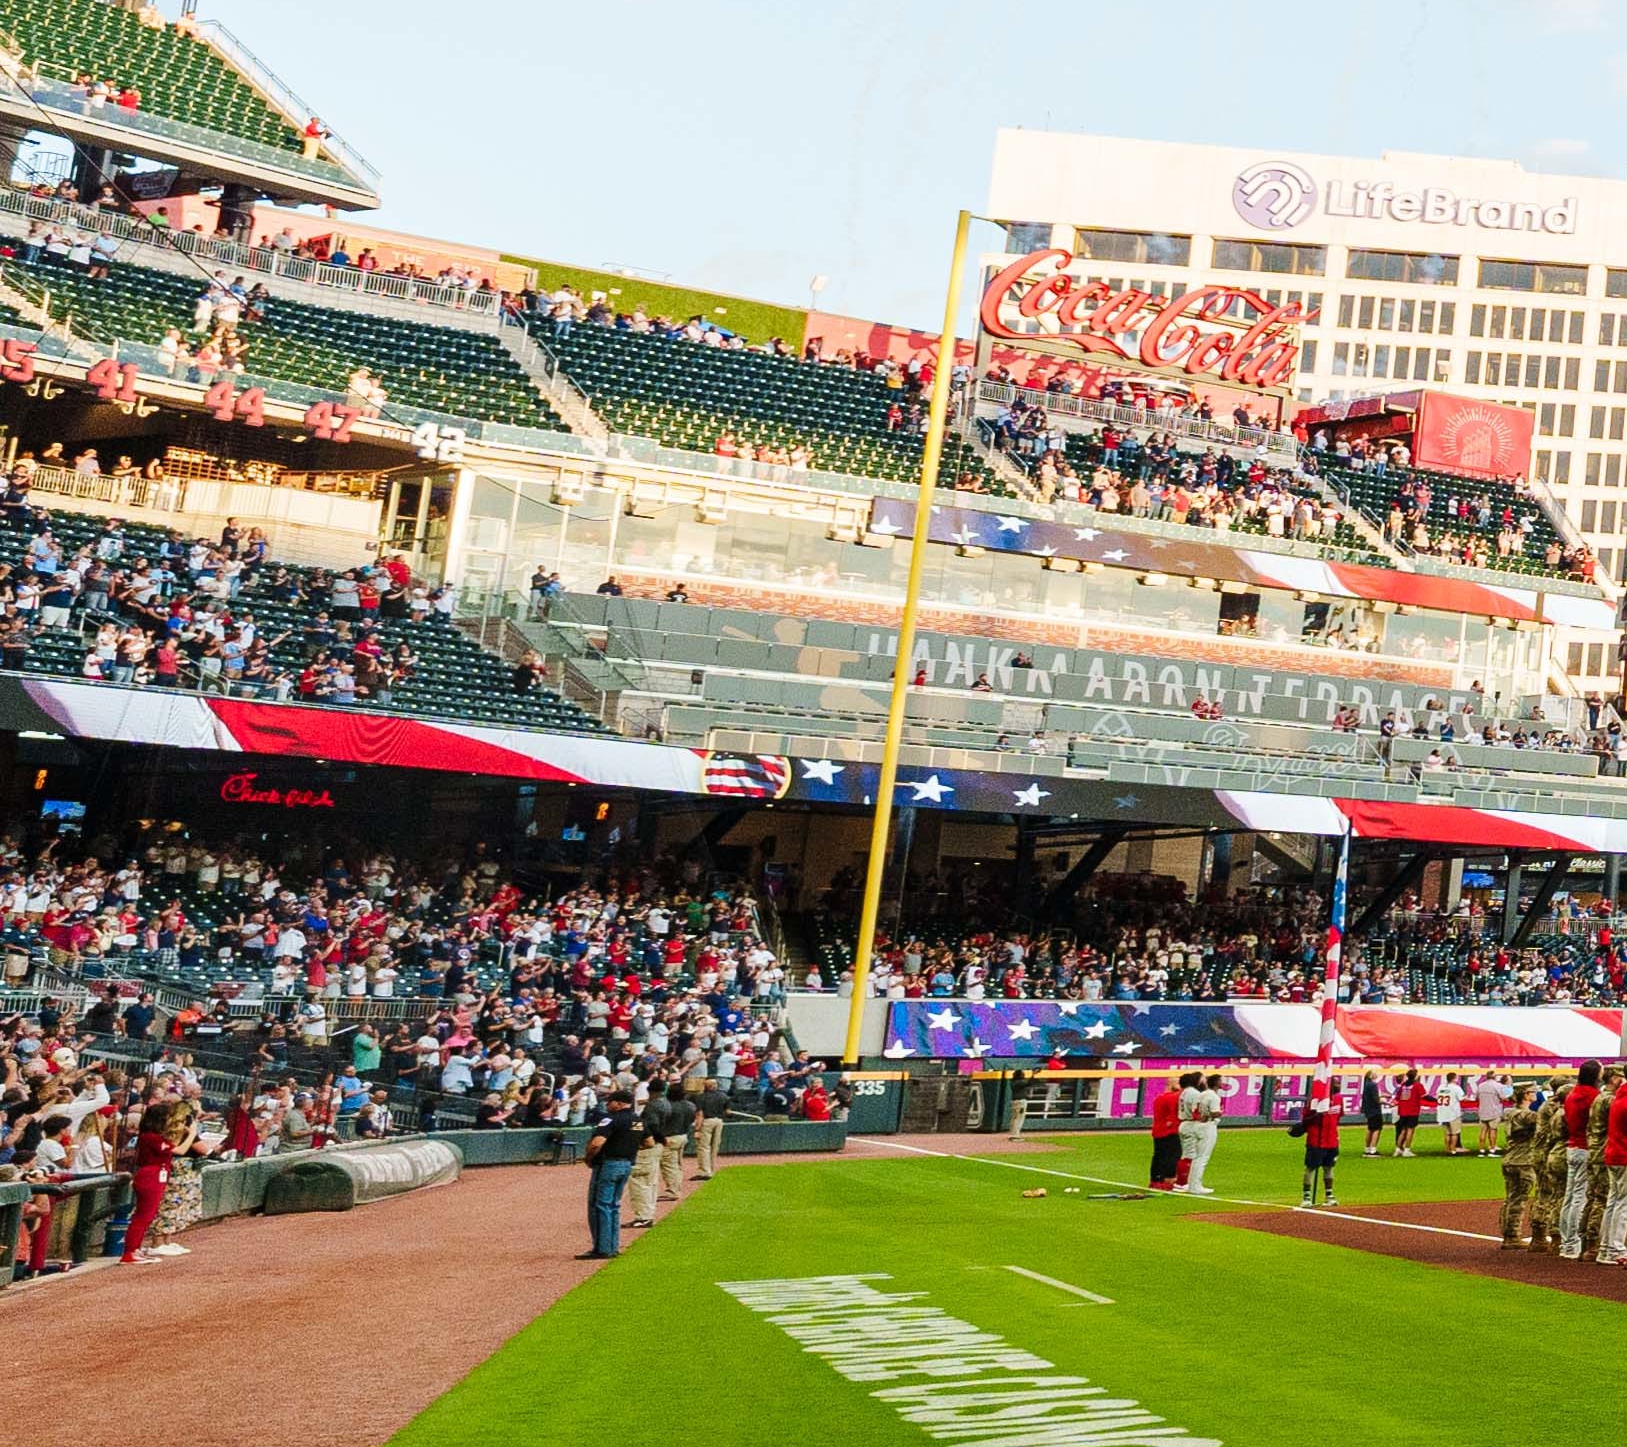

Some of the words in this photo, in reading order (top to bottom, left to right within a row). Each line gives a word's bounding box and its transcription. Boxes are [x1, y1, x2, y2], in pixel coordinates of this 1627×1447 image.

[1325, 179, 1579, 234] LifeBrand
[980, 248, 1320, 388] Coca-Cola
[0, 338, 38, 382] 5
[87, 359, 140, 401] 41
[204, 382, 265, 427] 44
[304, 402, 362, 442] 47
[411, 423, 465, 462] 42
[855, 1081, 885, 1095] 335
[1437, 1095, 1450, 1106] 33
[764, 1307, 1055, 1382] CHEROKEE
